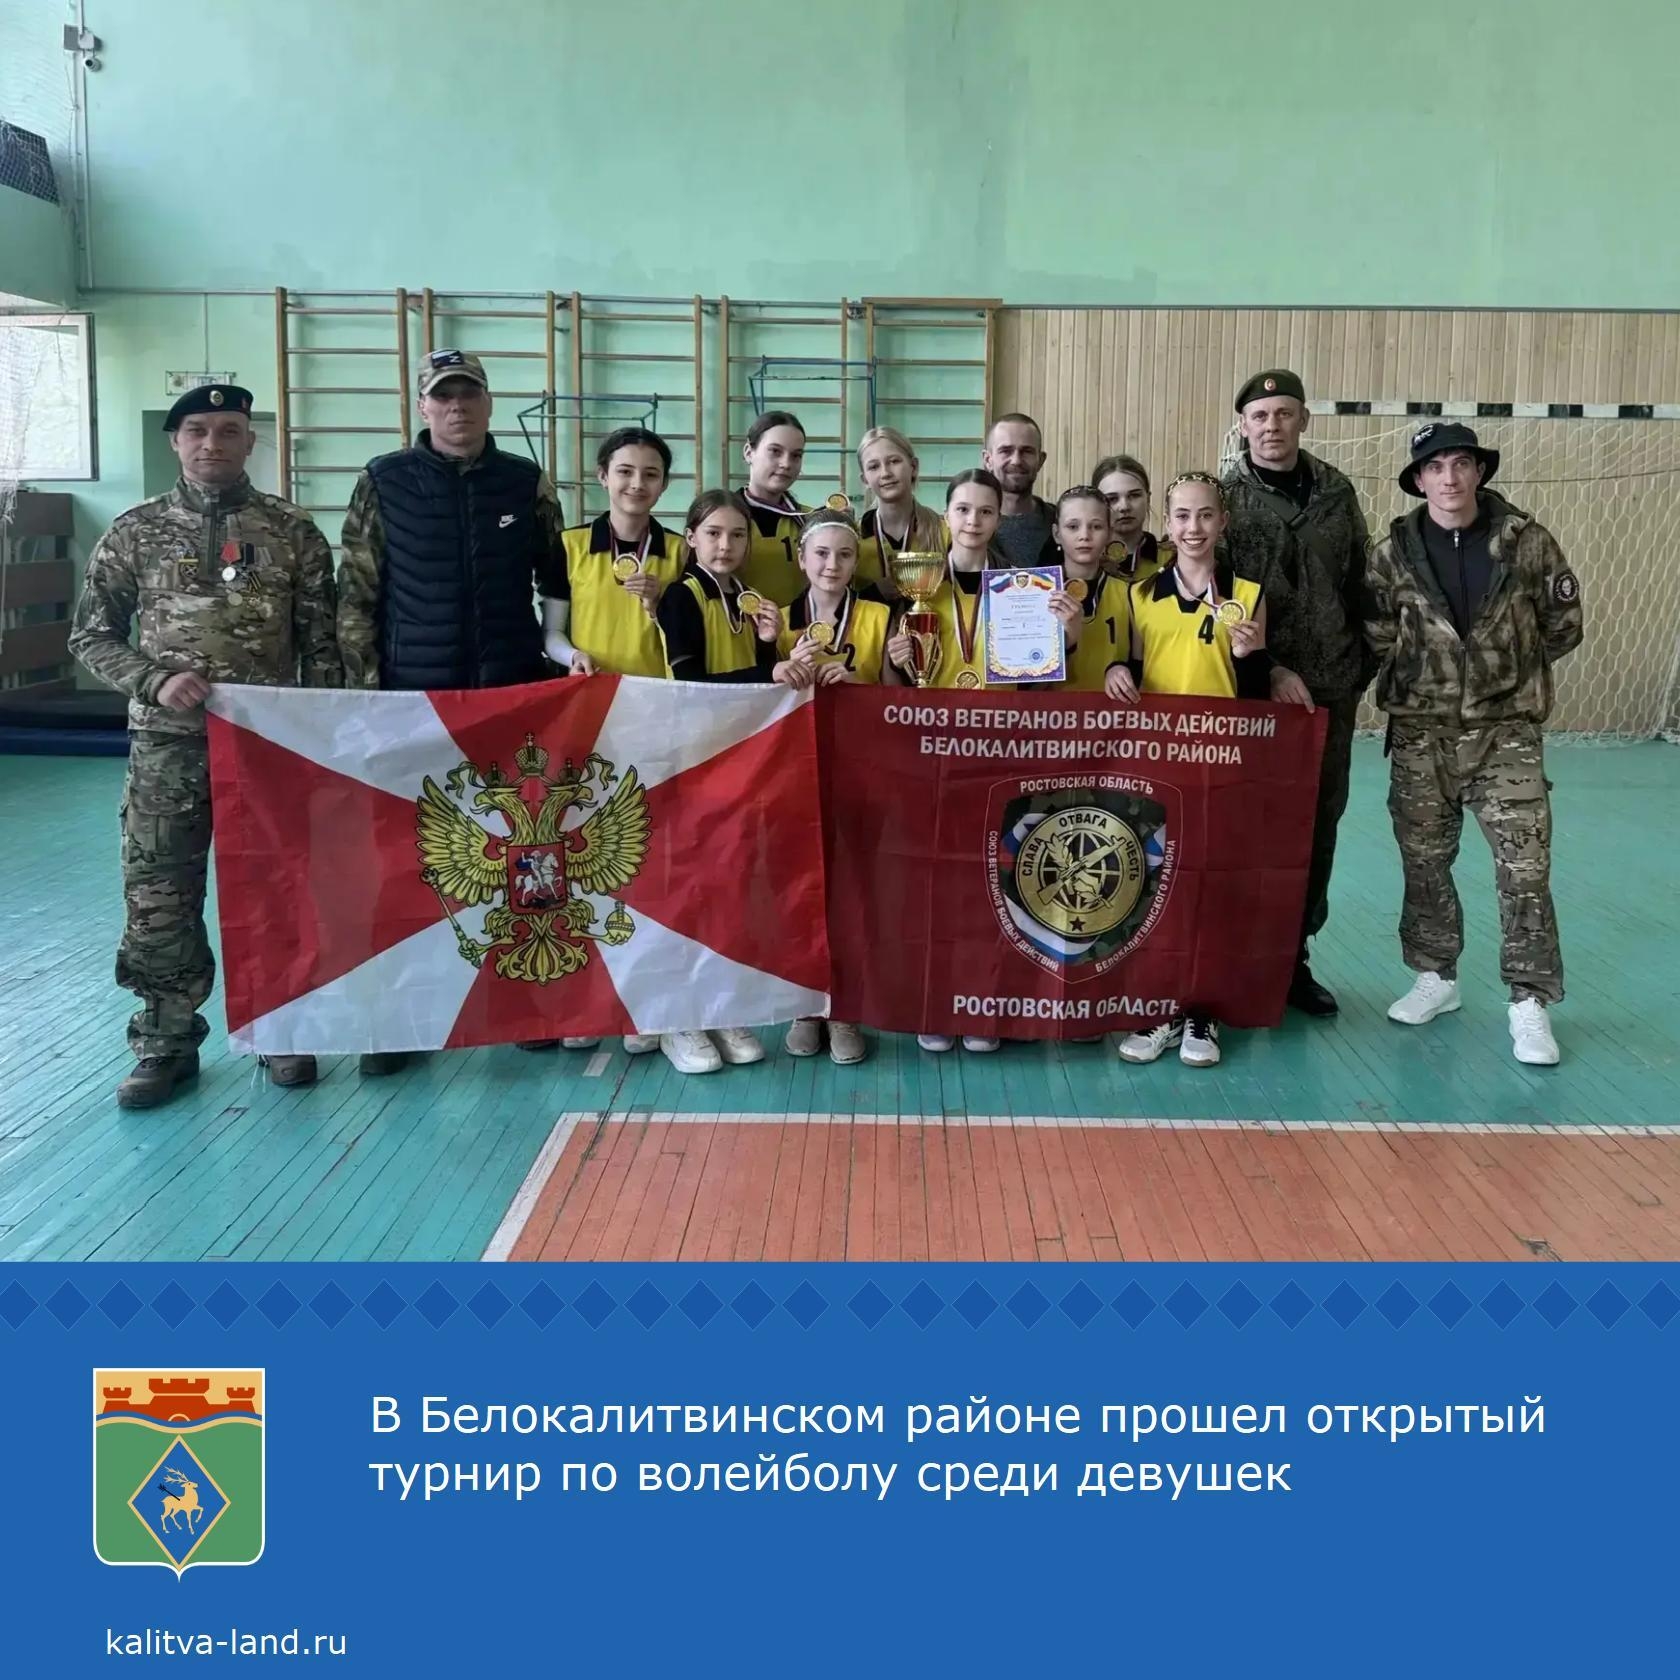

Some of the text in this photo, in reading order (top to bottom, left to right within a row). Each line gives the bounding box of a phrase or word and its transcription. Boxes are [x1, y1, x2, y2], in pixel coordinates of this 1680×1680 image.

[448, 355, 461, 363] Z
[1105, 617, 1115, 644] 1
[1198, 614, 1214, 645] 4
[841, 643, 856, 672] 2
[883, 704, 1276, 738] СОЮЗ ВЕТЕРАНОВ БОЕВЫХ ДЕЙСТВИЙ
[920, 735, 1242, 765] БЕЛОКАЛИТВИНСКОГО РАЙОНА
[1019, 776, 1154, 795] РОСТОВСКАЯ ОБЛАСТЬ
[1058, 813, 1108, 829] ОТВАГА
[988, 830, 998, 856] СОЮЗ
[1022, 837, 1045, 877] СЛАВА
[1126, 840, 1140, 881] ЧЕСТЬ
[988, 857, 1003, 907] ВЕТЕРАНОВ
[998, 906, 1020, 942] БОЕВЫХ
[1095, 883, 1168, 972] БЕЛОКАЛИТВИНСКОГО
[953, 995, 1180, 1020] РОСТОВСКАЯ ОБЛАСТЬ
